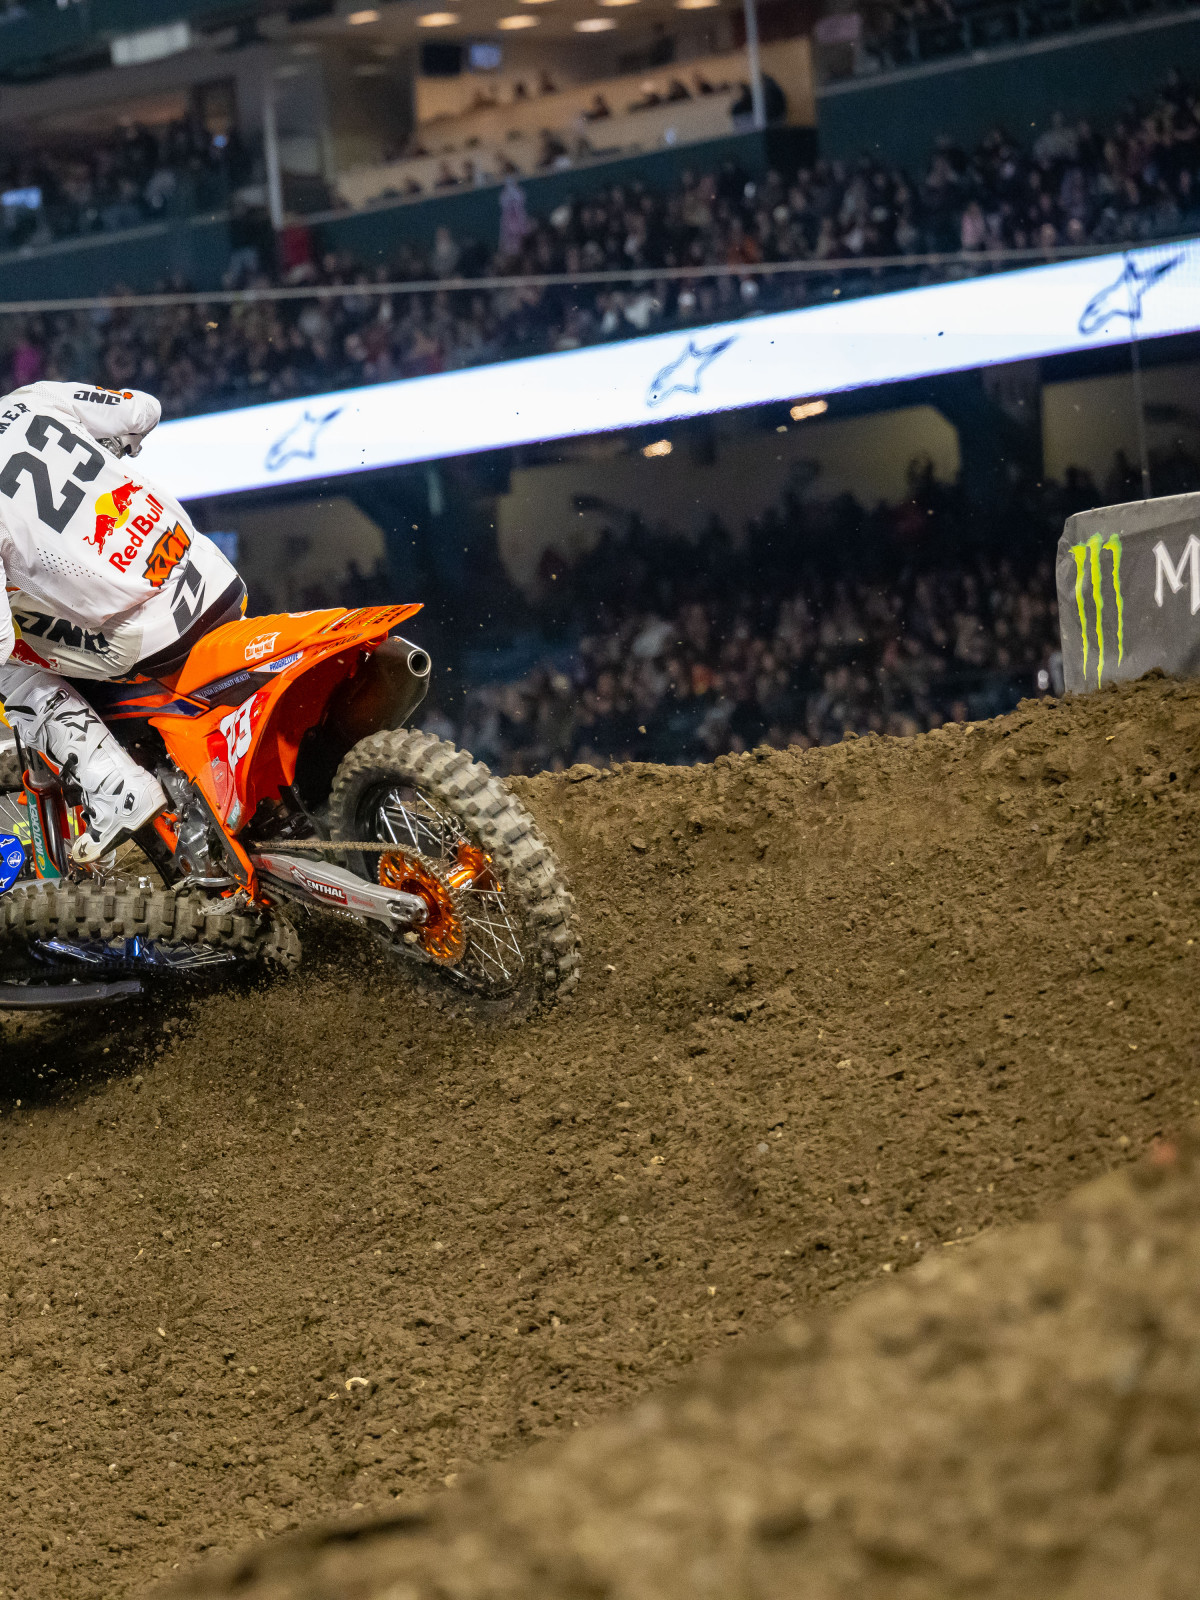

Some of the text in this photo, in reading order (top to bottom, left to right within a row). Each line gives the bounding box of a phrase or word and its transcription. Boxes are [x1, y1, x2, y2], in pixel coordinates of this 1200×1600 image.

[142, 521, 191, 588] KTM
[234, 673, 251, 684] HEALTH
[269, 652, 299, 671] PROGRESSIVE
[220, 694, 258, 777] 23
[29, 802, 44, 855] MOTOREX
